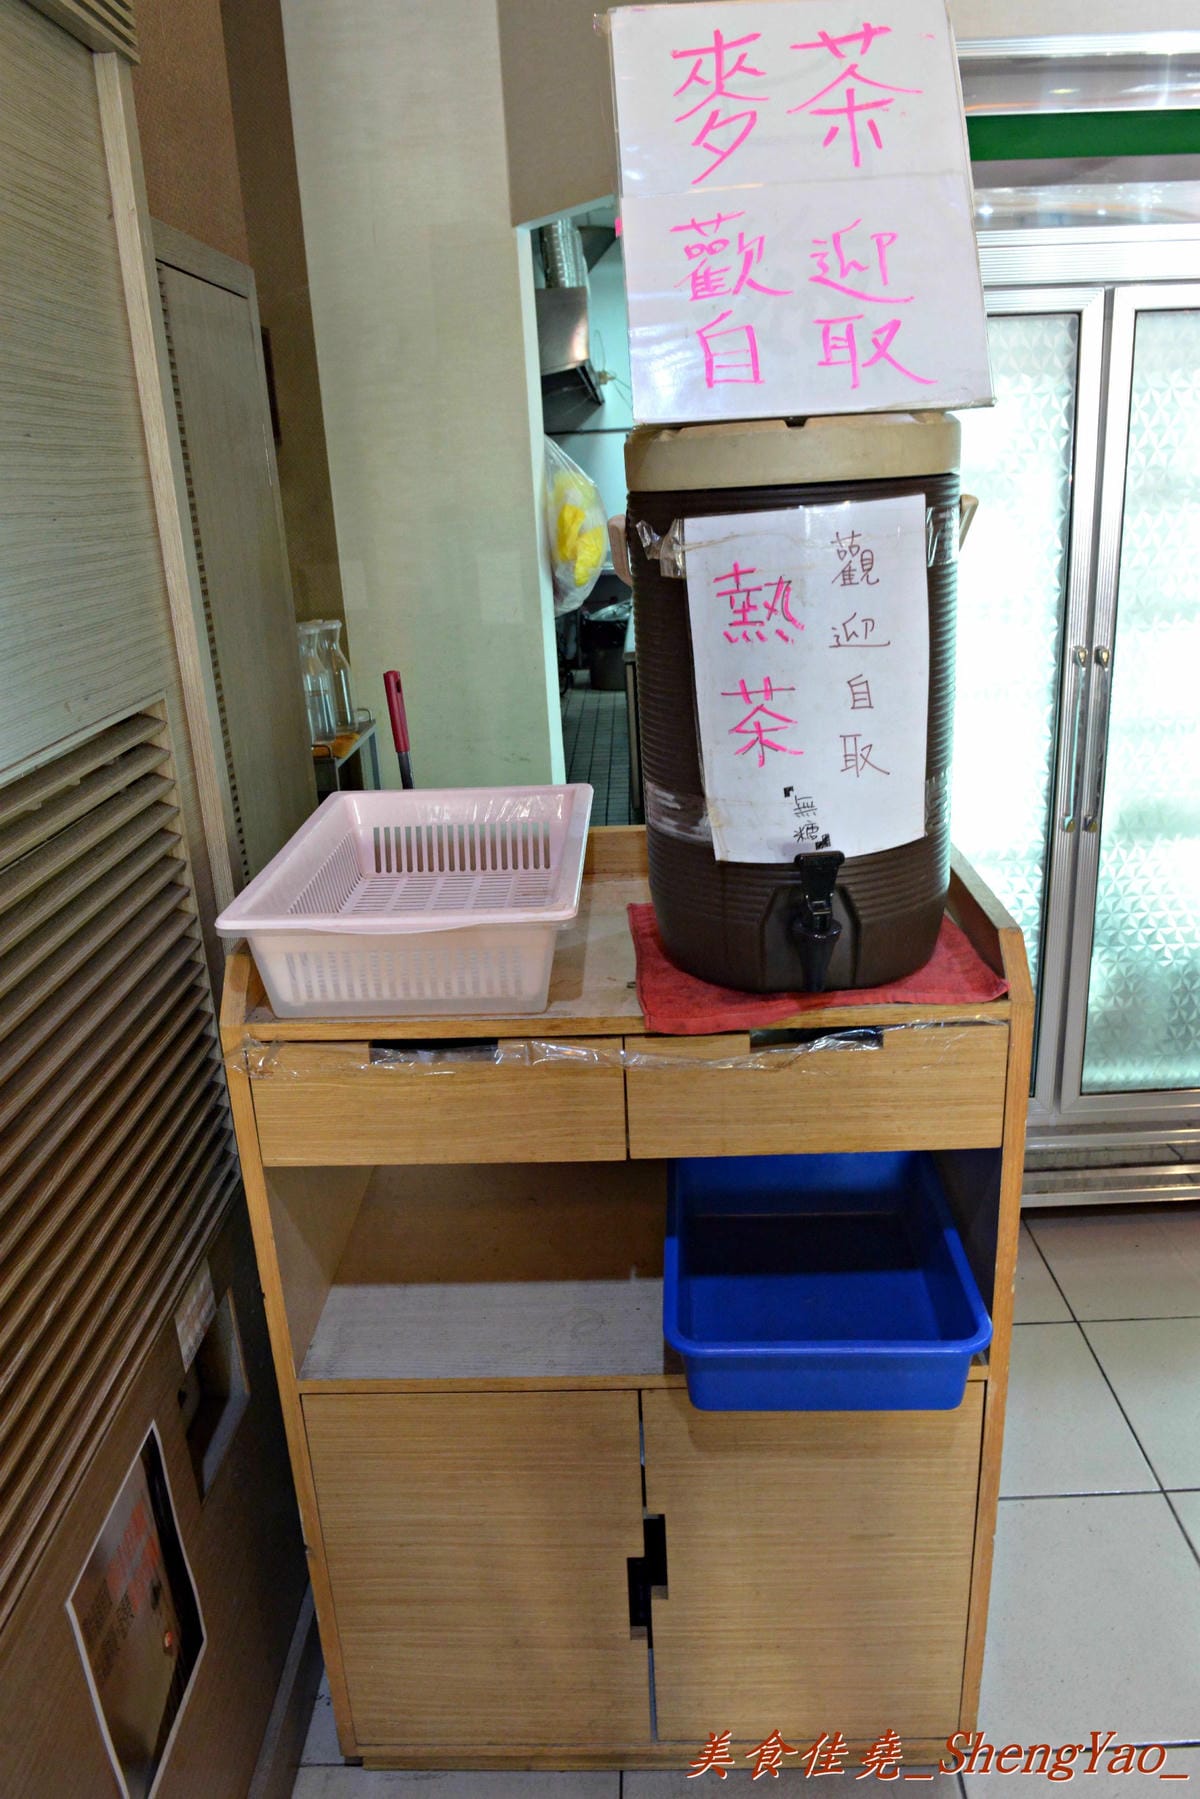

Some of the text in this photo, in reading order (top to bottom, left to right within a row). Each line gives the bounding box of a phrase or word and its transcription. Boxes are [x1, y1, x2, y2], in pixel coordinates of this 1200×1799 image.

[671, 21, 924, 186] 麥茶
[670, 210, 914, 304] 歡迎
[696, 309, 937, 389] 自取
[713, 561, 805, 768] 熱茶
